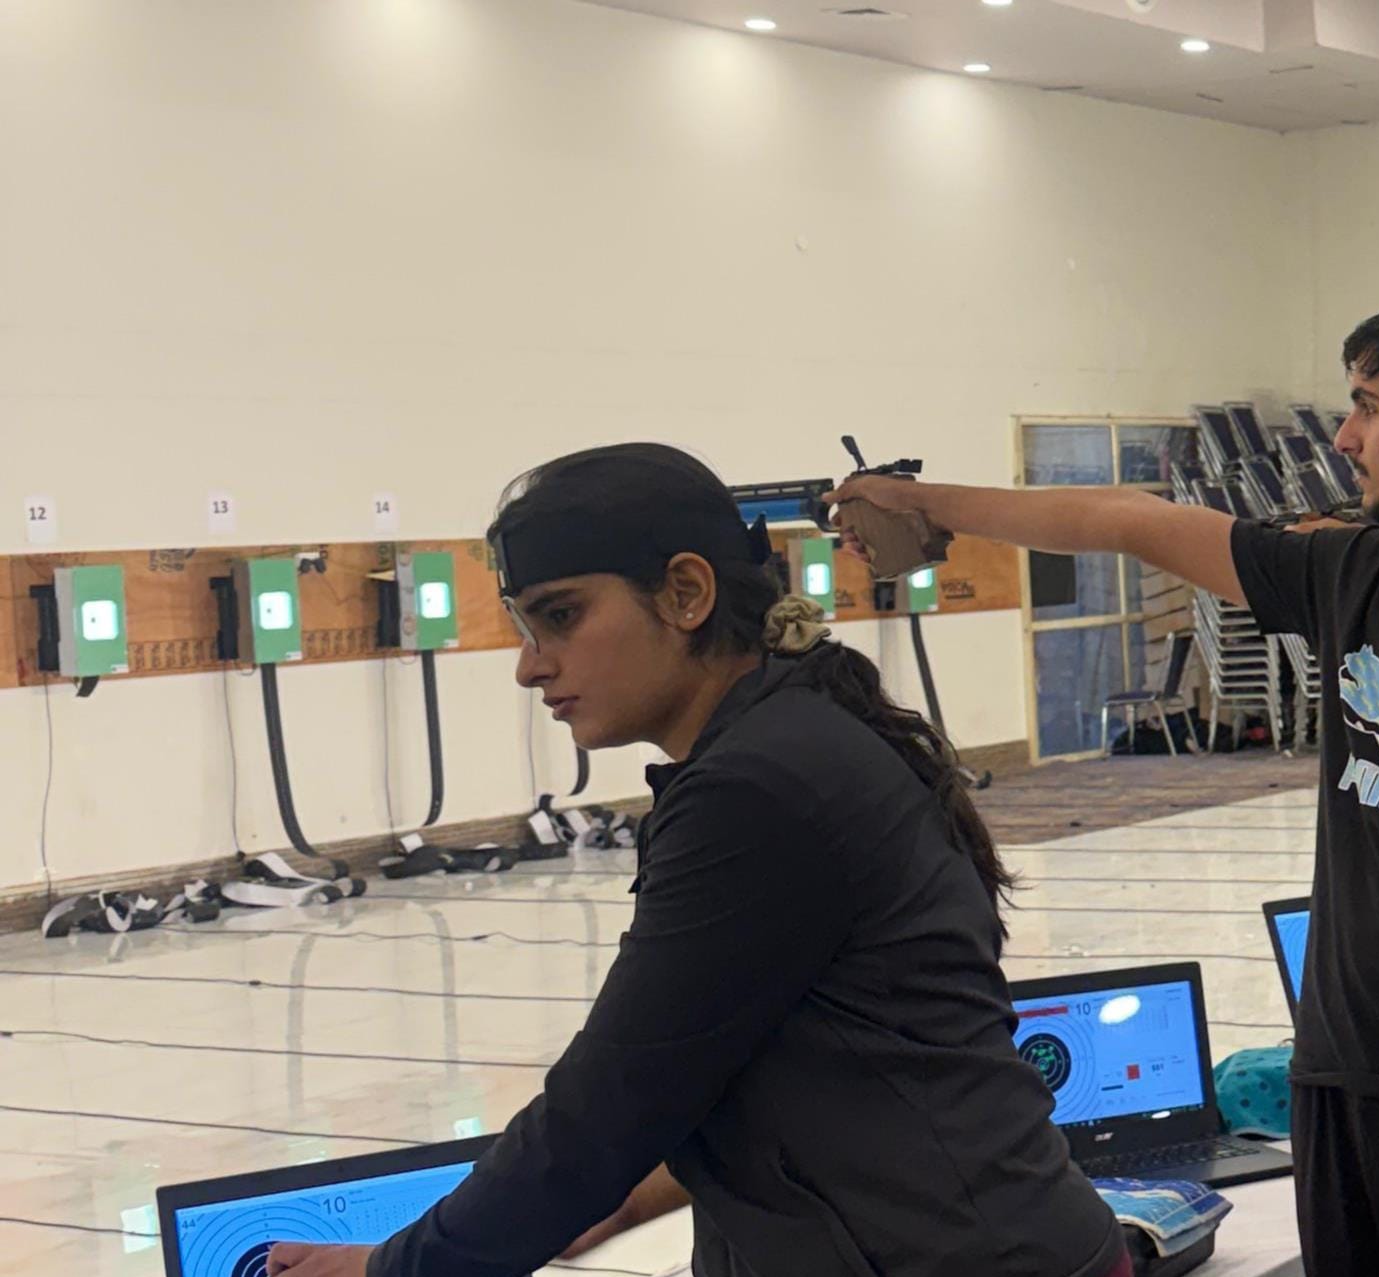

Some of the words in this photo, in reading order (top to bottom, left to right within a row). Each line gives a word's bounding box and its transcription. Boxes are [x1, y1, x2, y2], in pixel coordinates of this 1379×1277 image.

[29, 507, 47, 521] 12
[212, 501, 229, 515] 13
[375, 501, 390, 515] 14
[1076, 1001, 1092, 1016] 10
[322, 1195, 347, 1215] 10
[181, 1218, 196, 1230] 44
